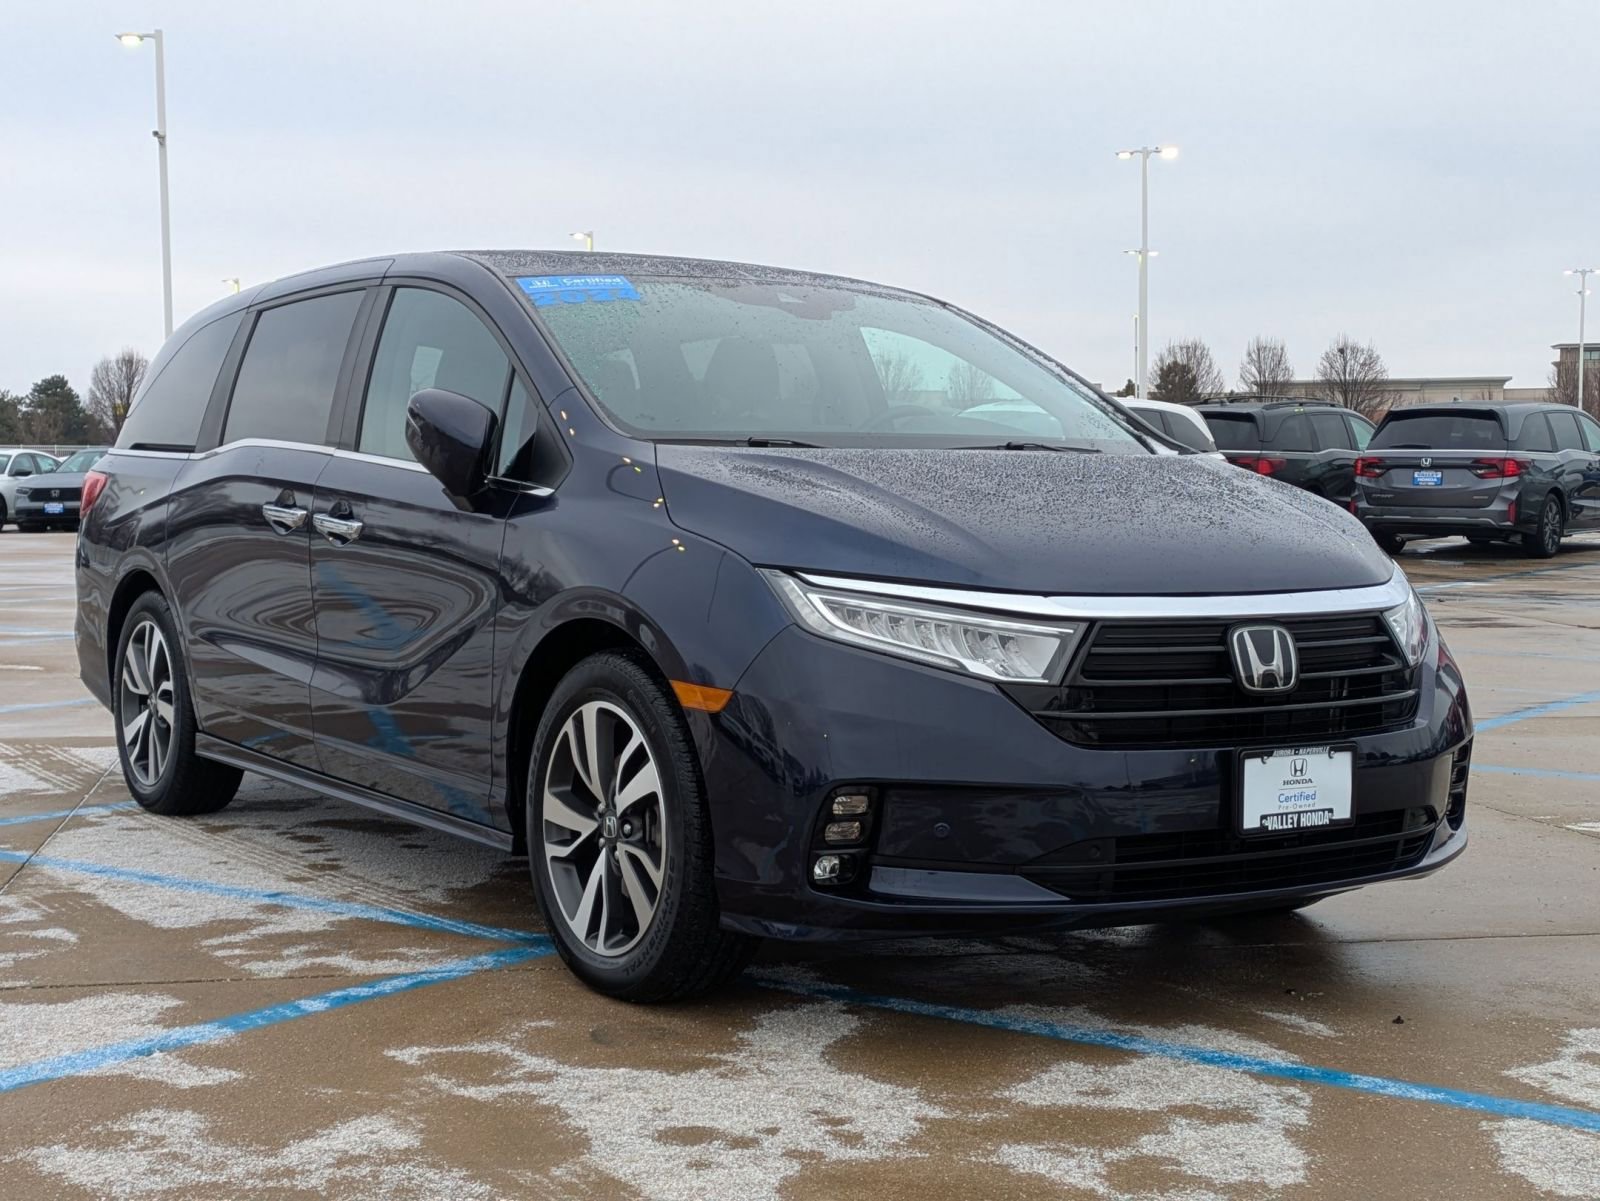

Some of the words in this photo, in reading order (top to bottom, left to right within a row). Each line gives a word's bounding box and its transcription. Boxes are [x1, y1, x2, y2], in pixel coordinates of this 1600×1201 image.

[1282, 778, 1313, 786] HONDA
[1278, 790, 1317, 804] Certified
[1278, 802, 1316, 811] Pre-Owned
[1266, 813, 1299, 831] VALLEY
[1300, 811, 1330, 827] HONDA
